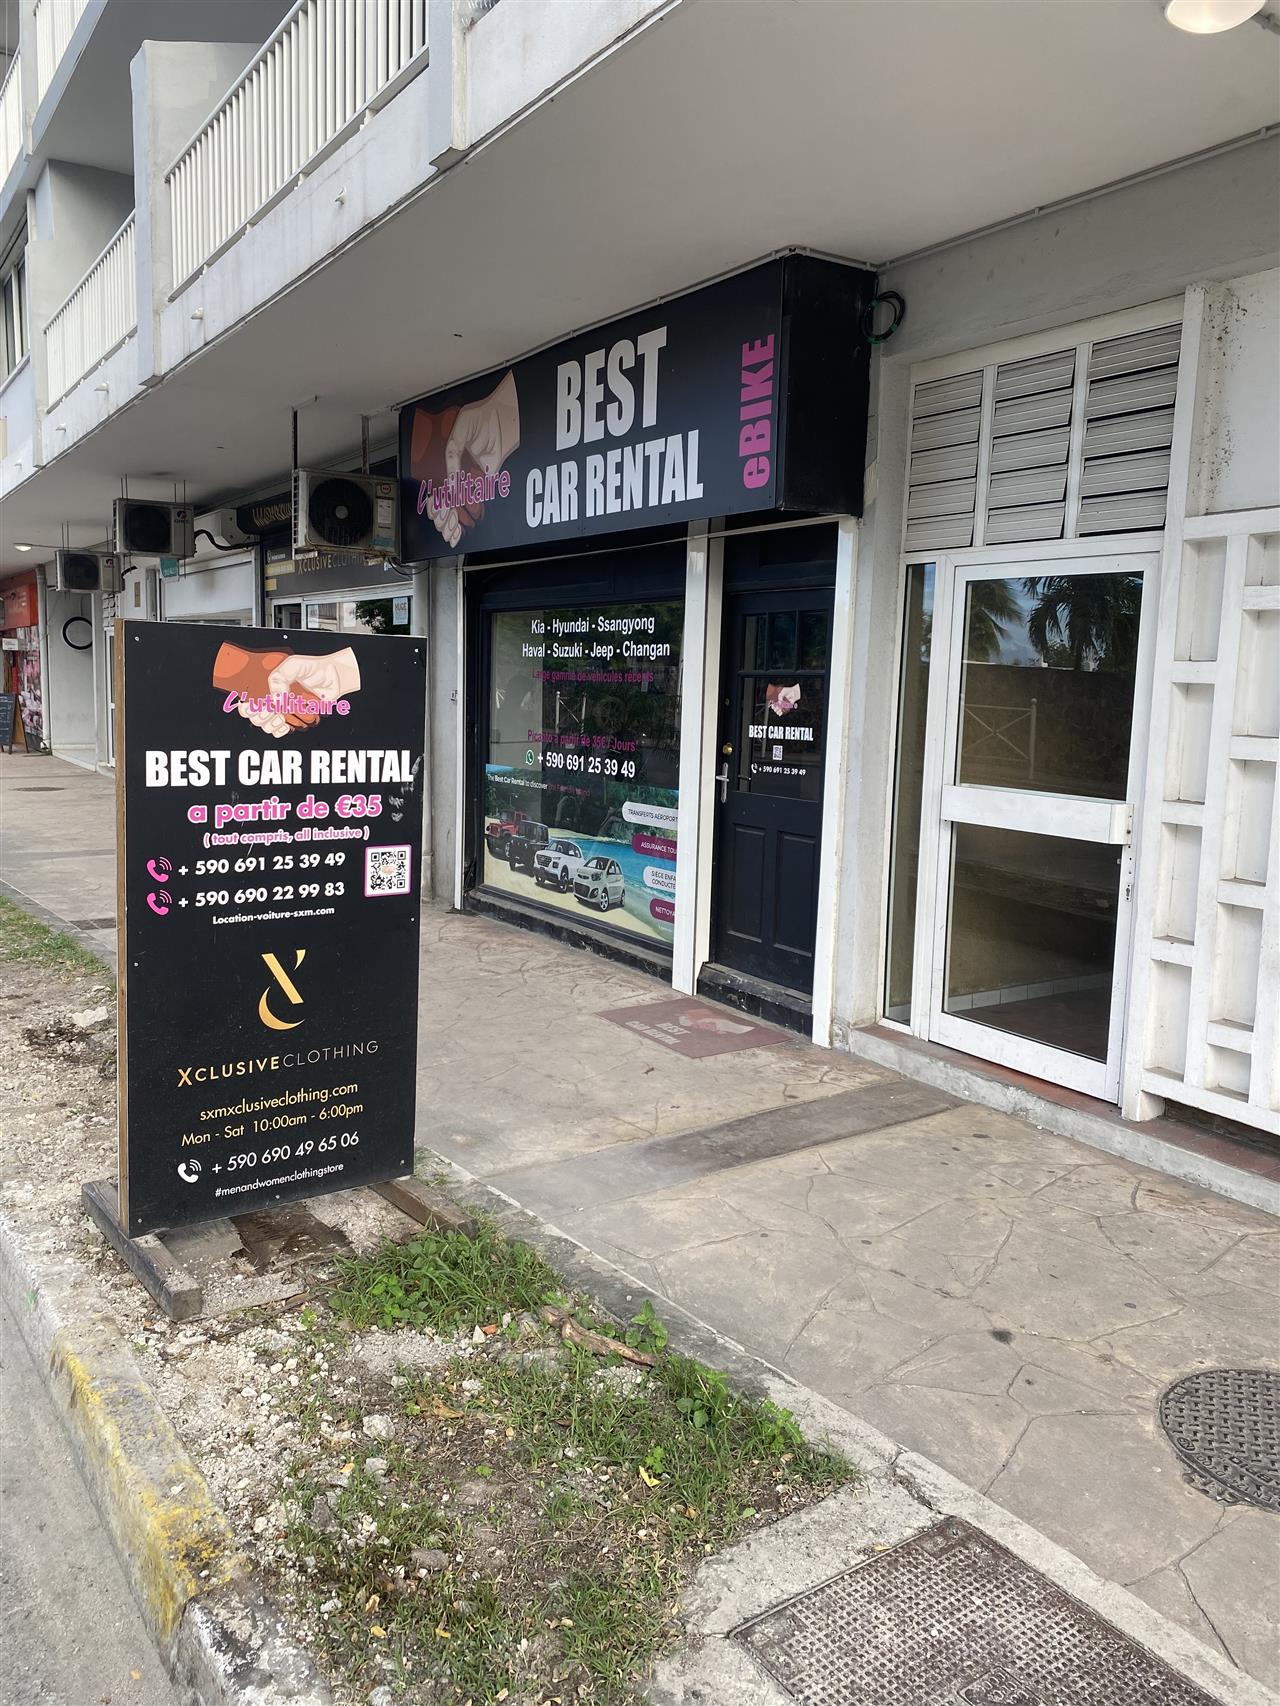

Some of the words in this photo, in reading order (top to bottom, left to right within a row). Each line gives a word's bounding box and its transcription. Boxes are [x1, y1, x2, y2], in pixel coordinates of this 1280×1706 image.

[556, 326, 667, 451] BEST
[739, 334, 775, 489] eBIKE
[525, 460, 579, 529] CAR
[585, 429, 704, 518] RENTAL
[531, 619, 545, 634] Kia
[552, 617, 589, 637] Hyundai
[597, 616, 655, 635] Ssangyong
[522, 643, 545, 657] Haval
[552, 642, 583, 658] Suzuki
[590, 642, 614, 660] Jeep
[622, 641, 670, 661] Changan
[222, 690, 351, 716] L'utilitaire
[748, 725, 767, 739] BEST
[768, 725, 784, 740] CAR
[785, 726, 814, 741] RENTAL
[145, 750, 231, 787] BEST
[238, 750, 302, 786] CAR
[310, 750, 414, 784] RENTAL
[537, 753, 543, 764] +
[546, 751, 564, 769] 590
[566, 754, 584, 772] 691
[588, 756, 601, 774] 25
[604, 758, 618, 776] 39
[621, 760, 636, 778] 49
[763, 765, 773, 773] 590
[773, 766, 782, 774] 691
[495, 775, 503, 783] Best
[511, 777, 525, 786] Rental
[530, 781, 548, 790] discover
[188, 805, 207, 823] a
[215, 797, 291, 828] partir
[297, 795, 329, 819] de
[335, 794, 382, 819] €35
[628, 808, 654, 819] TRANSFERTS
[212, 832, 238, 845] tout
[240, 829, 293, 845] compris,
[294, 828, 310, 841] all
[312, 827, 361, 841] inclusive
[640, 841, 667, 853] ASSURANCE
[178, 864, 189, 876] +
[195, 858, 229, 876] 590
[234, 856, 266, 874] 691
[273, 855, 294, 871] 25
[299, 853, 320, 869] 39
[324, 851, 346, 867] 49
[178, 896, 189, 908] +
[195, 890, 229, 908] 590
[234, 888, 268, 905] 690
[272, 886, 294, 901] 22
[298, 883, 320, 899] 99
[325, 881, 345, 897] 83
[212, 908, 335, 925] Location-voiture-sxm.com
[200, 1082, 359, 1122] sxmxclusiveclothing.com
[181, 1131, 211, 1147] Mon
[224, 1124, 245, 1139] Sat
[253, 1114, 307, 1133] 10:00am
[319, 1103, 364, 1121] 6:00pm
[211, 1163, 222, 1174] +
[227, 1155, 257, 1172] 590
[262, 1146, 291, 1165] 690
[295, 1140, 314, 1157] 49
[318, 1134, 337, 1152] 65
[340, 1131, 359, 1148] 06
[214, 1163, 344, 1198] #menandwomenclothingstore
